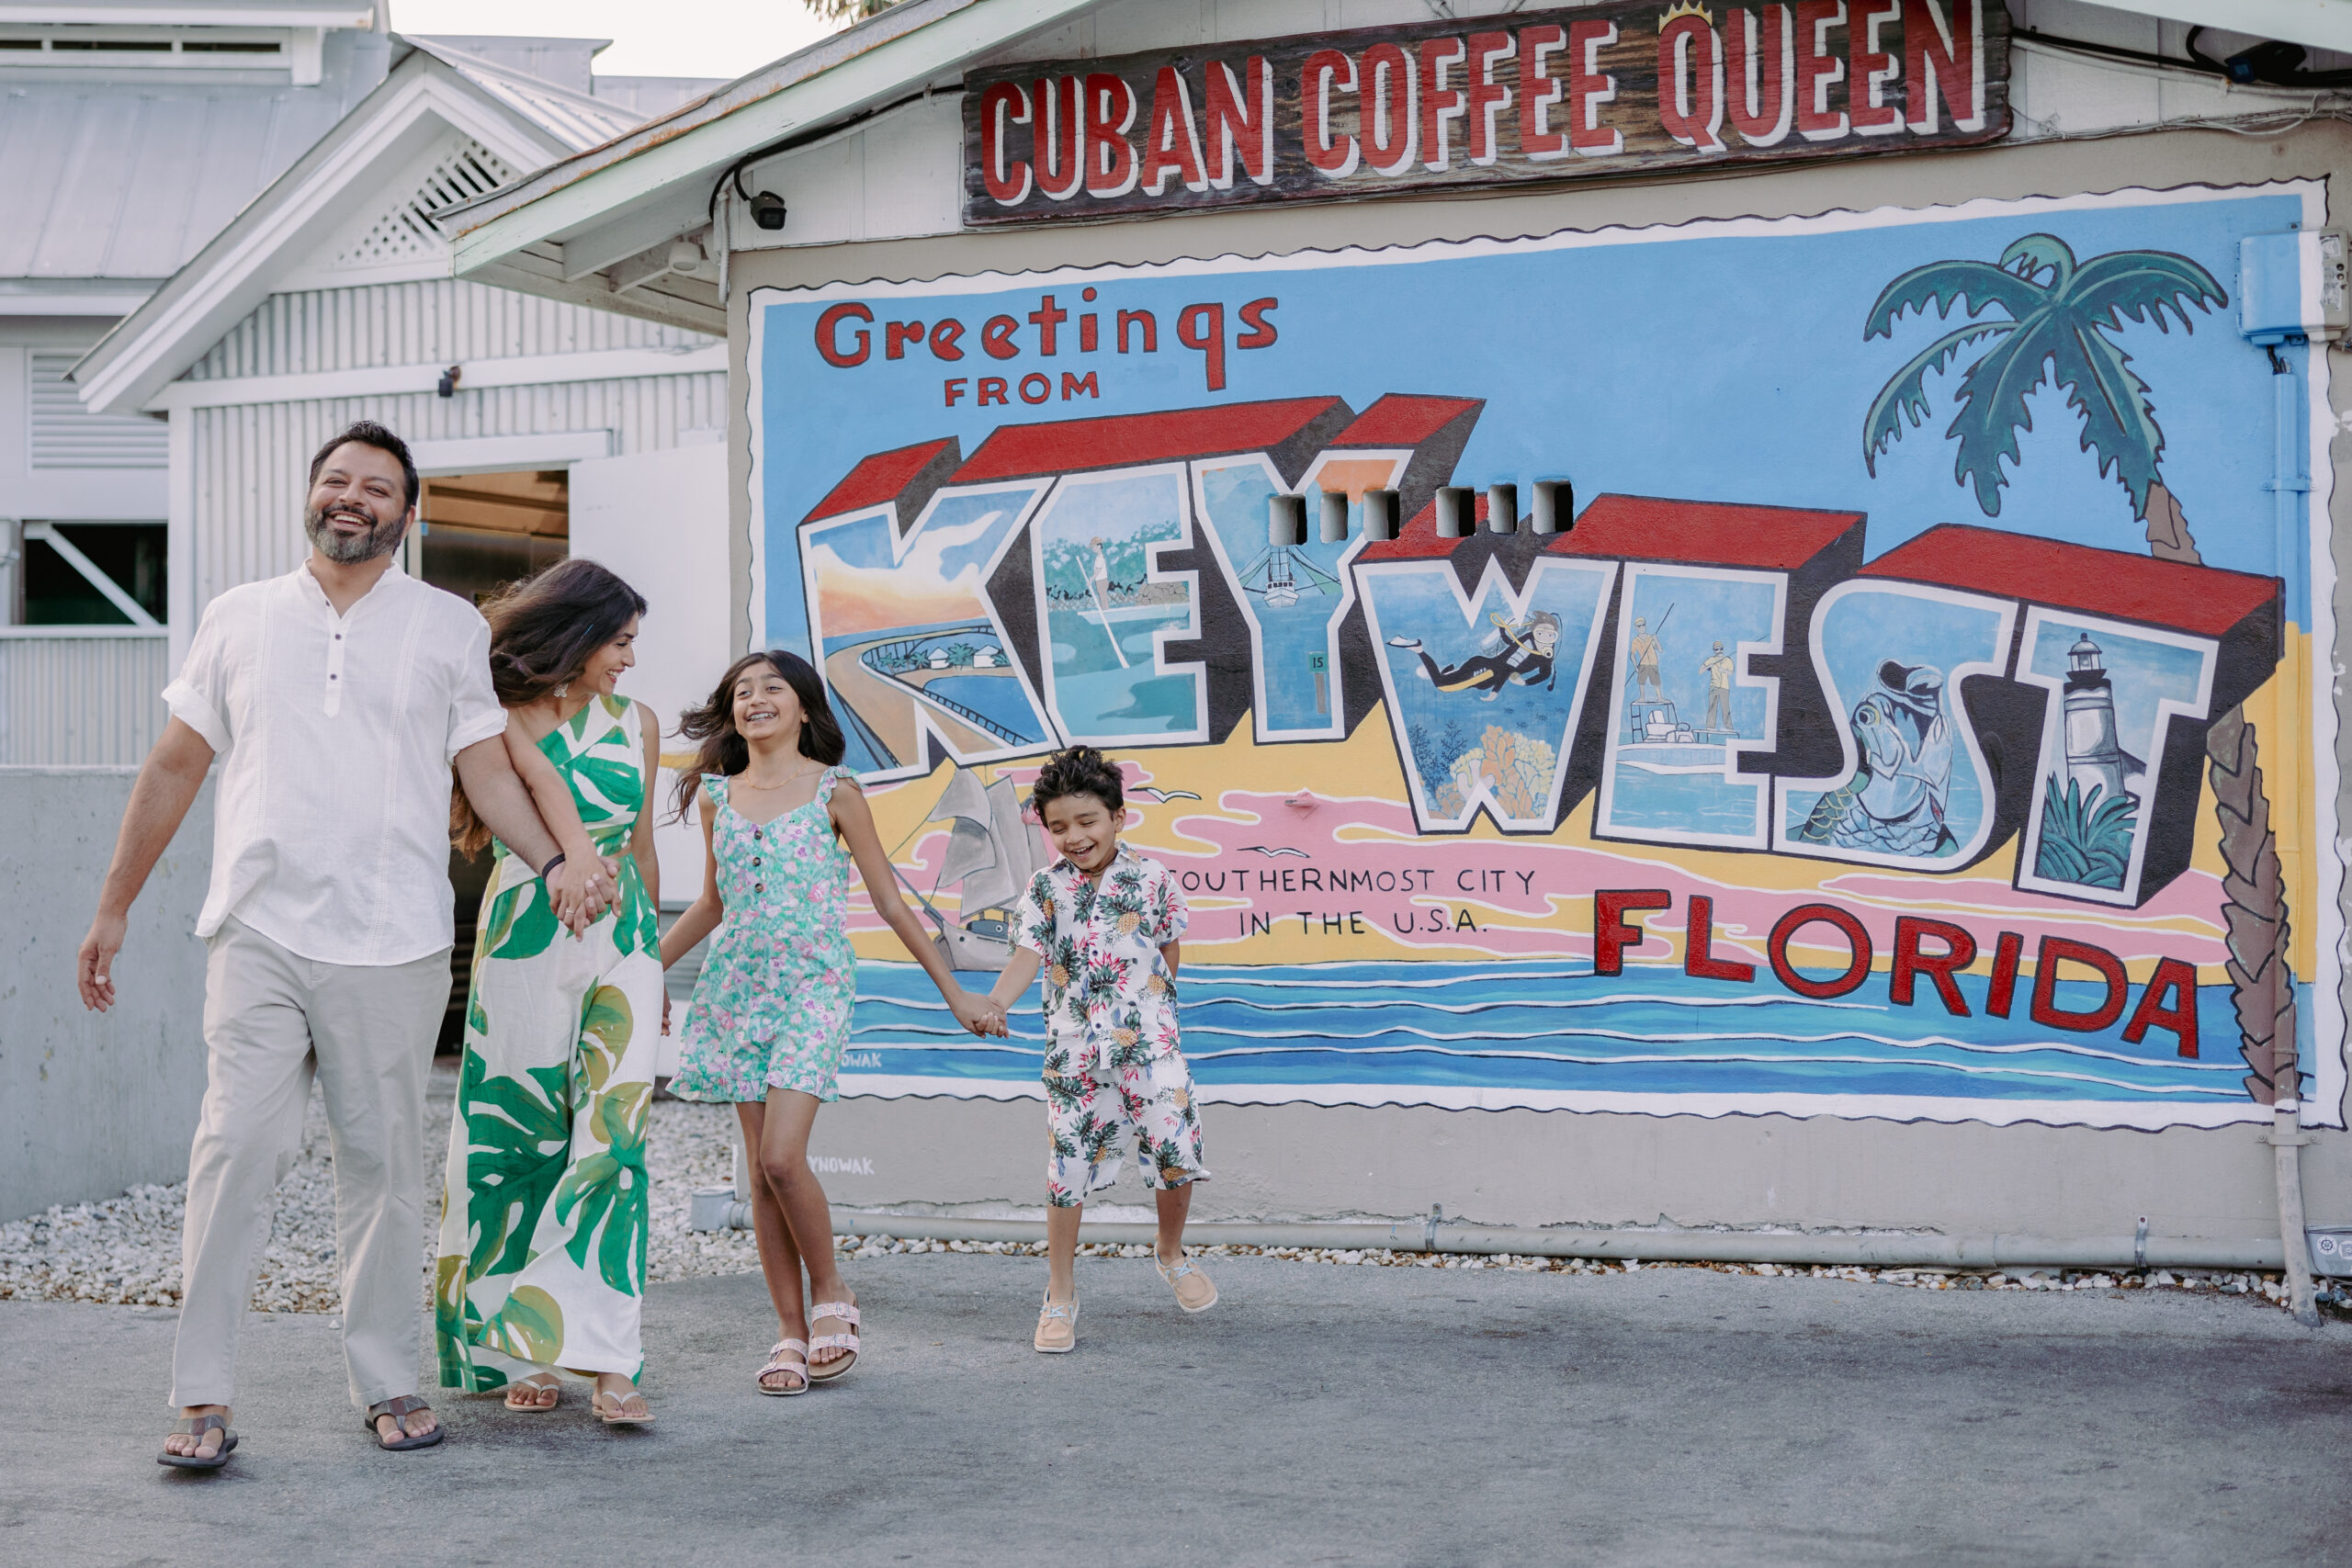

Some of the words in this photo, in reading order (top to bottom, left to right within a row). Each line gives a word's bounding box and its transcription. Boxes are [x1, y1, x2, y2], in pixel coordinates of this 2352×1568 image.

[980, 55, 1274, 207] CUBAN
[1301, 19, 1624, 178] COFFEE
[1657, 0, 1986, 152] QUEEN
[814, 287, 1279, 392] Greetings
[944, 371, 1101, 407] FROM
[797, 448, 1416, 785] KEY
[1353, 551, 2221, 908] WEST
[1168, 867, 1436, 893] OUTHERNMOST
[1457, 868, 1536, 896] CITY
[1239, 911, 1271, 937] IN
[1295, 910, 1366, 935] THE
[1394, 908, 1488, 934] U.S.A.
[1594, 888, 2200, 1059] FLORIDA
